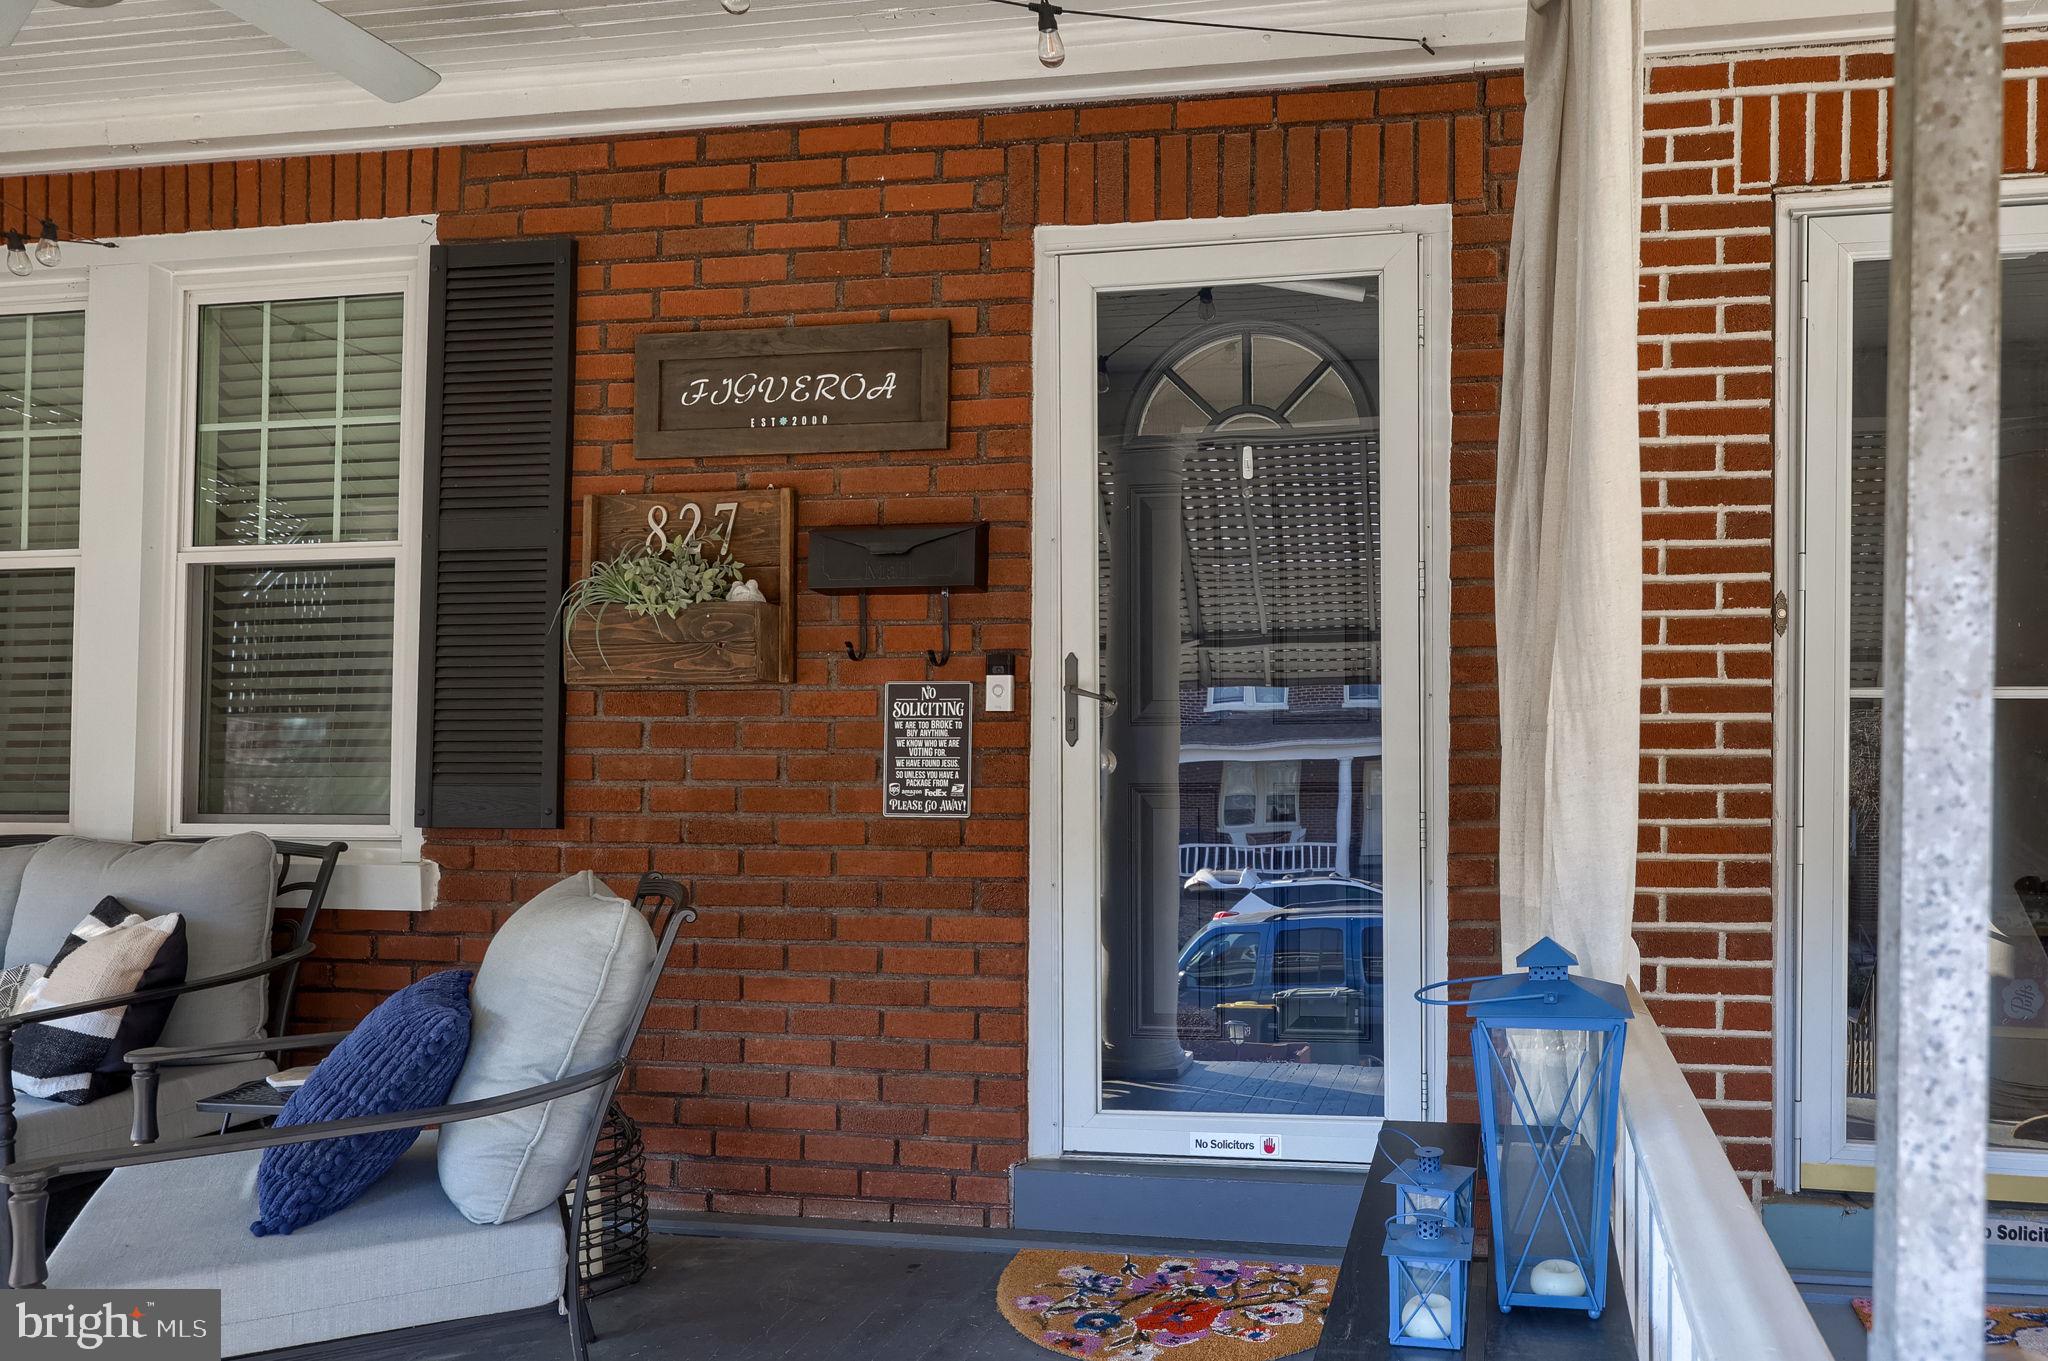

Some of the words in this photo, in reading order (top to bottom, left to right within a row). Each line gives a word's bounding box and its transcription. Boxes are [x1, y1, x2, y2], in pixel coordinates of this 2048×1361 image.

[681, 372, 897, 406] FIGUEROA
[750, 416, 775, 428] EST
[792, 414, 828, 426] 2000
[646, 502, 738, 555] 827
[864, 560, 914, 580] Mail
[893, 701, 964, 718] SOLICITING
[918, 721, 929, 729] TOO
[931, 720, 952, 729] BROKE
[955, 721, 962, 729] TO
[920, 729, 949, 737] ANYTHING.
[909, 748, 933, 756] VOTING
[889, 799, 922, 811] PLEASE
[925, 800, 938, 812] GO
[940, 800, 966, 812] AWAY!
[2010, 984, 2036, 1014] Puffs
[1195, 1139, 1208, 1148] No
[1210, 1139, 1255, 1150] Solicitors
